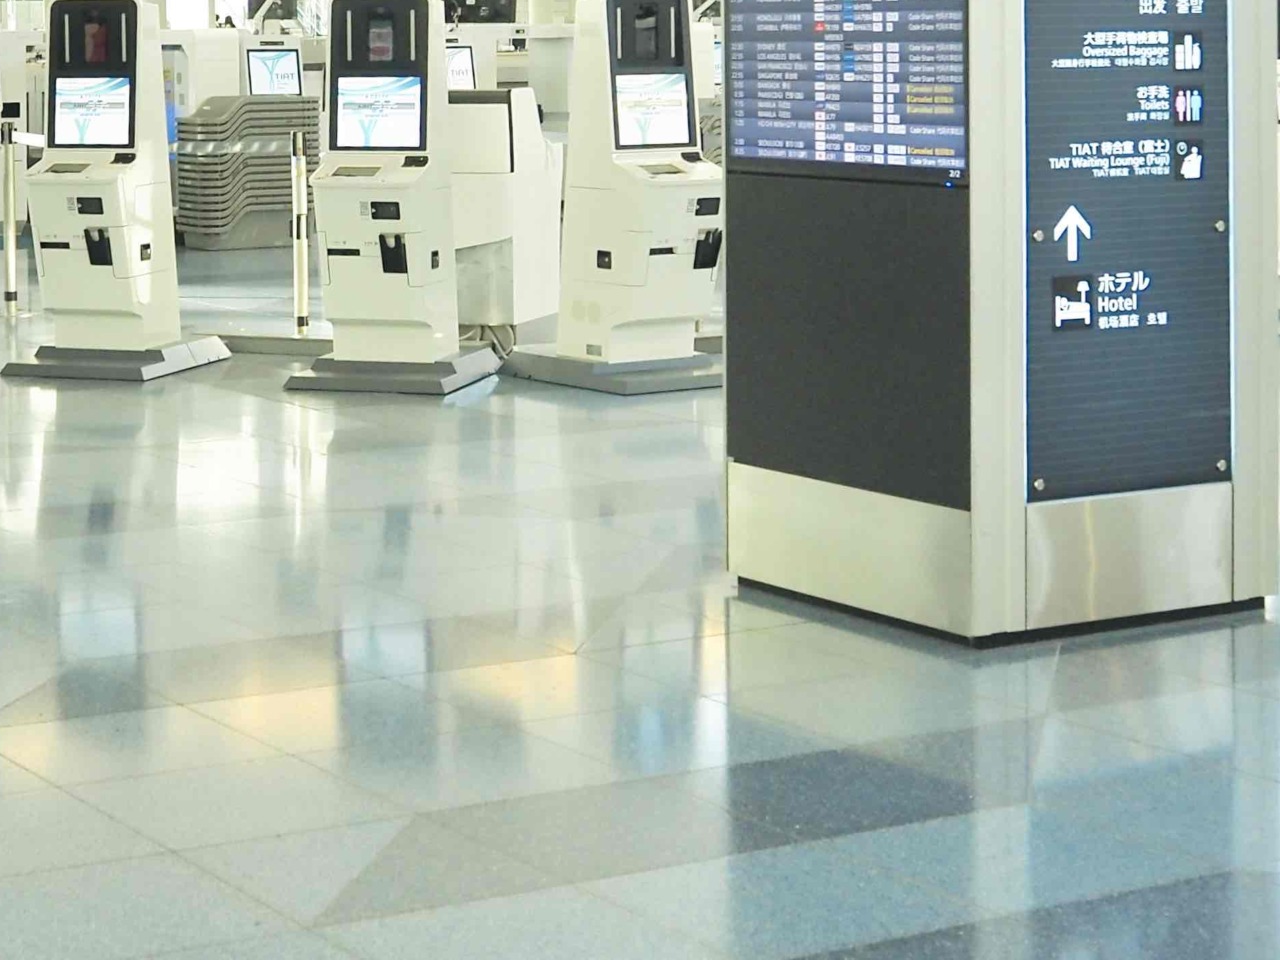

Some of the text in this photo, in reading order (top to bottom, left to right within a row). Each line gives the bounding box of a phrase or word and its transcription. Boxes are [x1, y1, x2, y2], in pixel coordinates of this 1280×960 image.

[1082, 44, 1169, 58] Oversized Baggage
[1136, 85, 1170, 100] お手洗
[1138, 99, 1170, 111] Toilets
[1069, 142, 1099, 156] TIAT
[1049, 153, 1170, 169] TIAT Waiting Lounge (Fuji)
[1097, 270, 1150, 294] ホテル
[1097, 292, 1137, 313] Hotel
